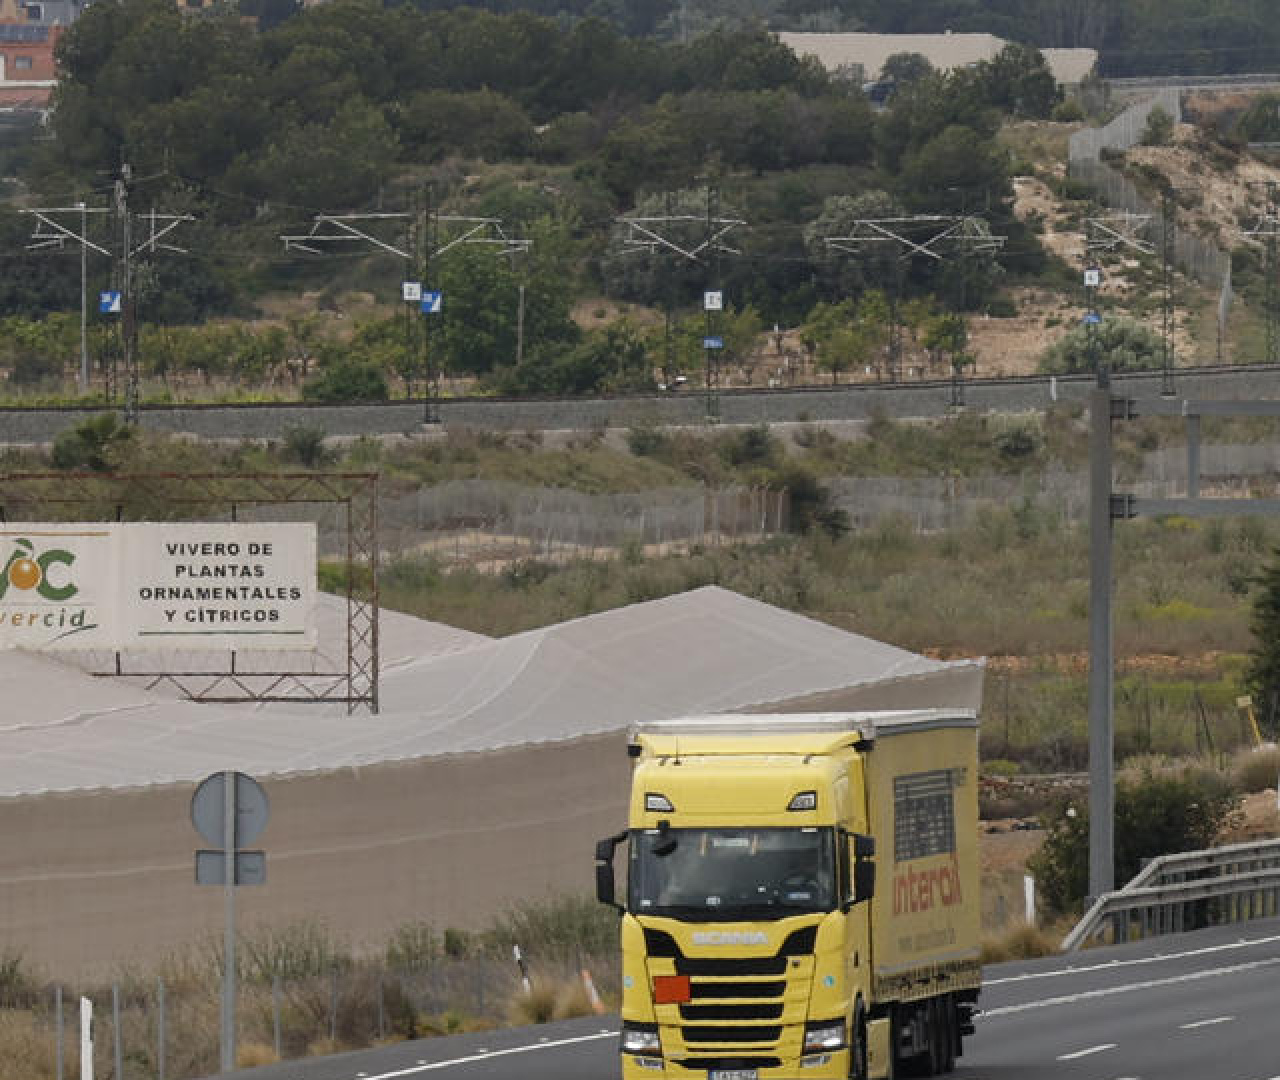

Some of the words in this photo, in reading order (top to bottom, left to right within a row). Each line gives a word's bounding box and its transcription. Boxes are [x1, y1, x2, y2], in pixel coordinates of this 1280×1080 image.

[166, 543, 241, 556] VIVERO
[248, 543, 273, 556] DE
[176, 564, 265, 577] PLANTAS
[139, 586, 302, 600] ORNAMENTALES
[165, 609, 176, 622] Y
[185, 605, 280, 623] CÍTRICOS
